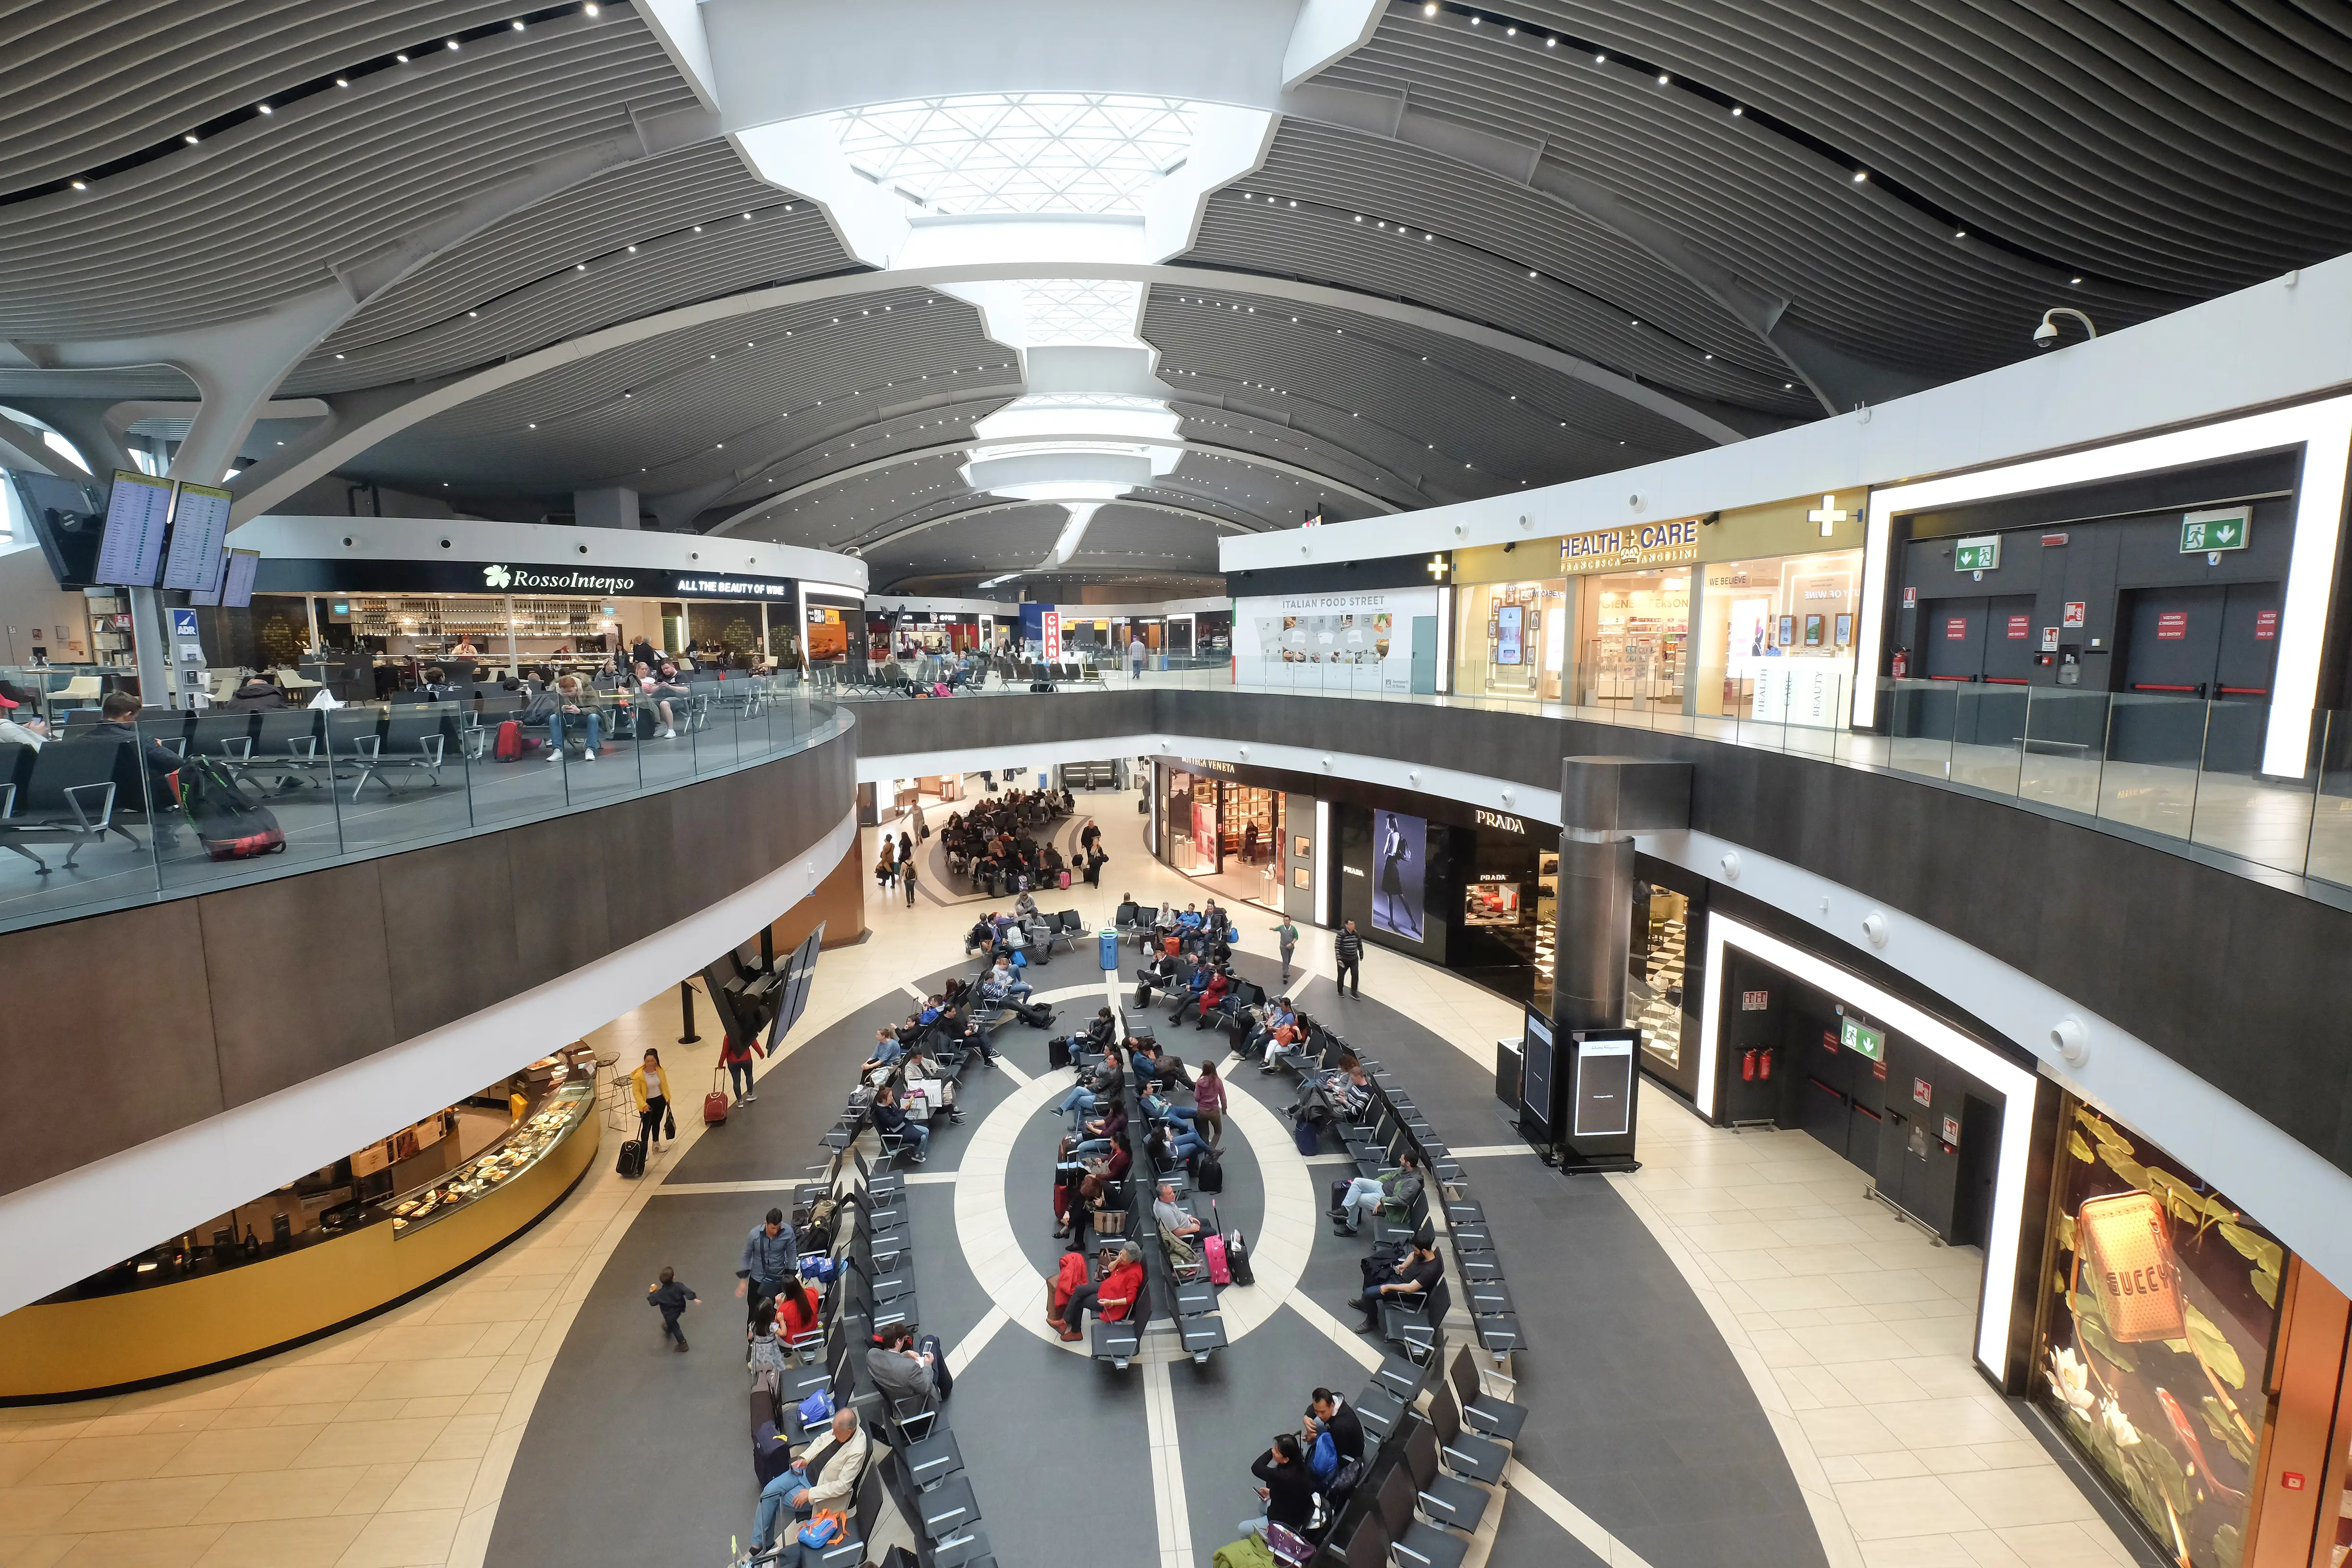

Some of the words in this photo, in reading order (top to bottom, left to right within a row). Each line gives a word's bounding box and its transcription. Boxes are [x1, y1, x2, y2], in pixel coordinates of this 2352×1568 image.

[127, 473, 159, 486] Departures
[192, 487, 219, 496] Departures
[1560, 531, 1620, 558] HEALTH
[1641, 520, 1697, 548] CARE
[513, 570, 634, 594] RossoIntenso
[1720, 576, 1747, 585] BELIEVE
[678, 580, 698, 591] ALL
[698, 581, 717, 592] THE
[718, 582, 754, 593] BEAUTY
[754, 584, 765, 594] OF
[766, 585, 784, 596] WINE
[1282, 599, 1317, 609] ITALIAN
[1321, 598, 1346, 607] FOOD
[1349, 596, 1384, 606] STREET
[1600, 600, 1634, 609] GIENE
[177, 626, 196, 635] ADR
[1758, 669, 1767, 712] HEALTH
[1784, 676, 1792, 706] CARE
[1813, 671, 1823, 716] BEAUTY
[1208, 760, 1235, 773] VENETA
[1475, 809, 1525, 835] PRADA
[1344, 866, 1364, 877] PRADA
